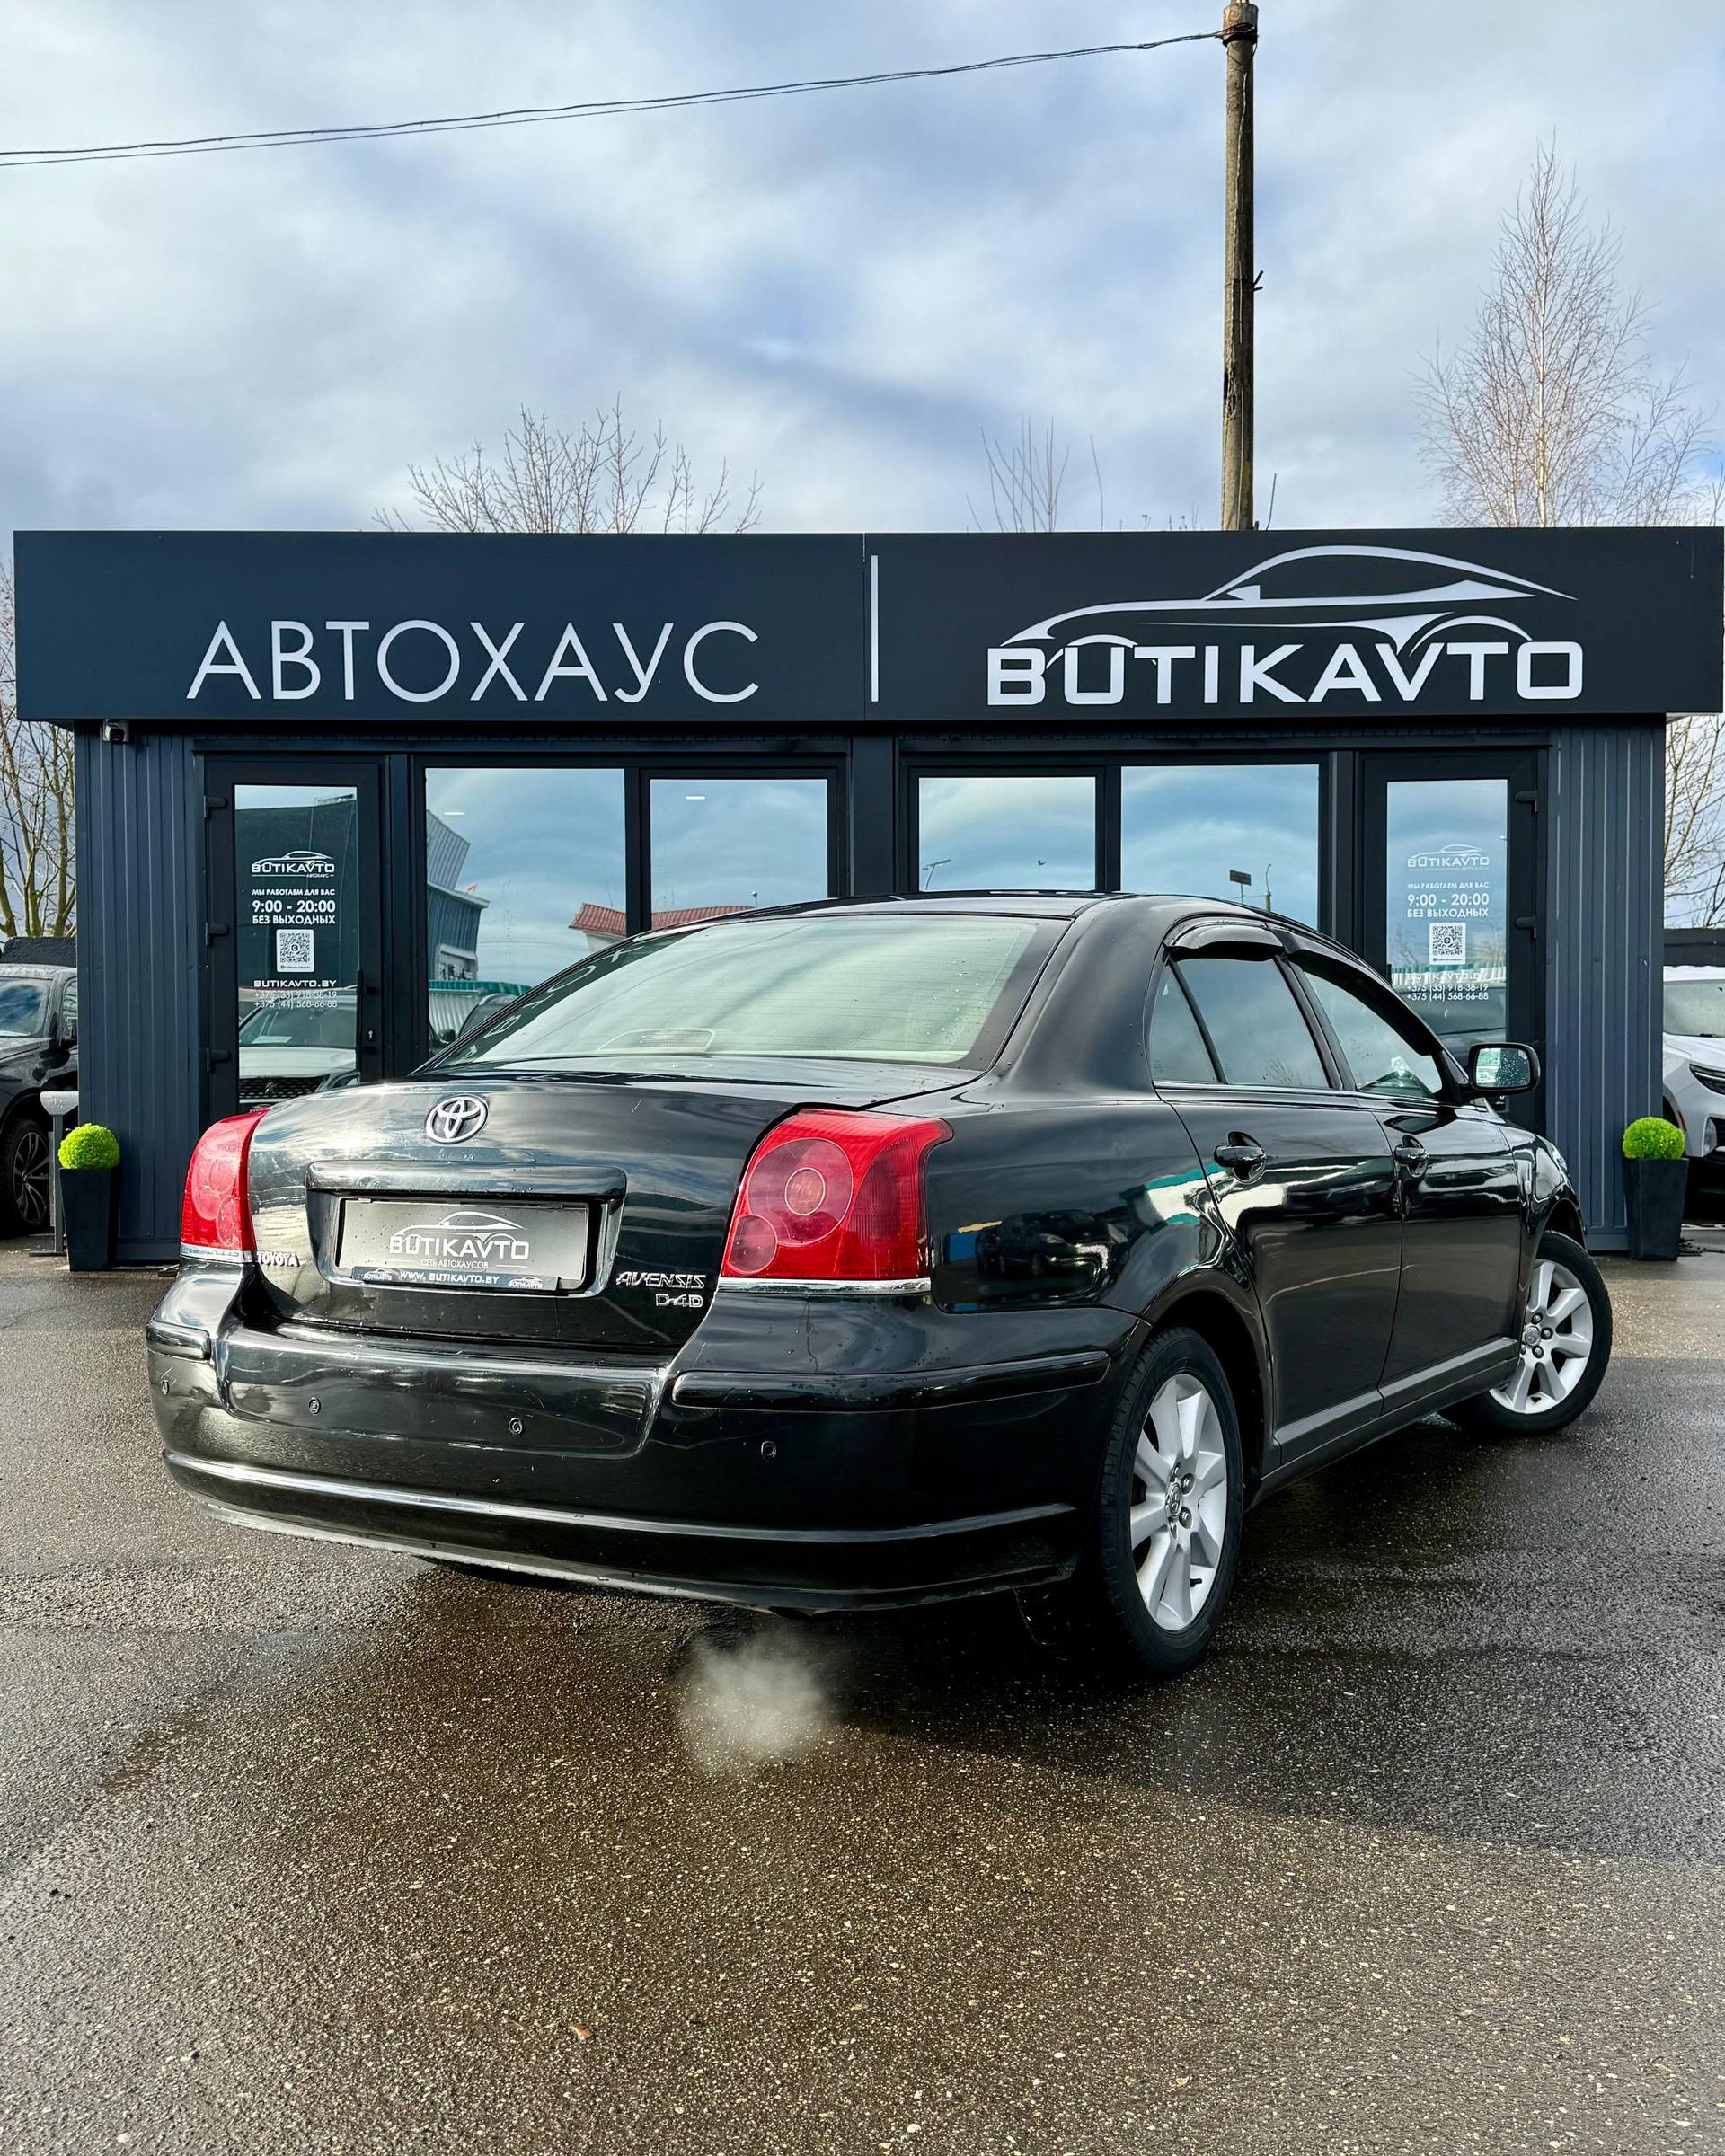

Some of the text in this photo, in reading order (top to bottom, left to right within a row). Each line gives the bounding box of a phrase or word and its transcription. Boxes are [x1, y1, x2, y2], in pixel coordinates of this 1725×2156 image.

[185, 620, 761, 704] АВТОХАУС
[987, 641, 1584, 706] BUTIKAVTO
[252, 862, 335, 873] BUTIKAVTO
[1407, 856, 1490, 868] BUTIKAVTO
[1407, 894, 1438, 906] 9:00
[1451, 892, 1490, 906] 20:00
[252, 900, 283, 913] 9:00
[296, 900, 336, 913] 20:00
[1407, 907, 1489, 918] БЕЗ ВЫХОДНЫХ
[252, 915, 336, 925] БЕЗ ВЫХОДНЫХ
[253, 979, 337, 987] BUTIKAVTO.BY
[1407, 983, 1489, 993] +375 (33) 918-38-19
[1407, 992, 1489, 1002] +375 (44) 568-66-88
[253, 999, 338, 1010] +375 (44) 568-66-88
[389, 1235, 530, 1260] BUTIKAVTO
[256, 1250, 299, 1267] TOYOTA
[420, 1259, 489, 1269] СЕТЬ АВТОХАУСОВ
[398, 1269, 500, 1286] WWW. BUTIKAVTO.BY
[615, 1271, 706, 1289] AVENSIS
[655, 1294, 703, 1308] D-4D
